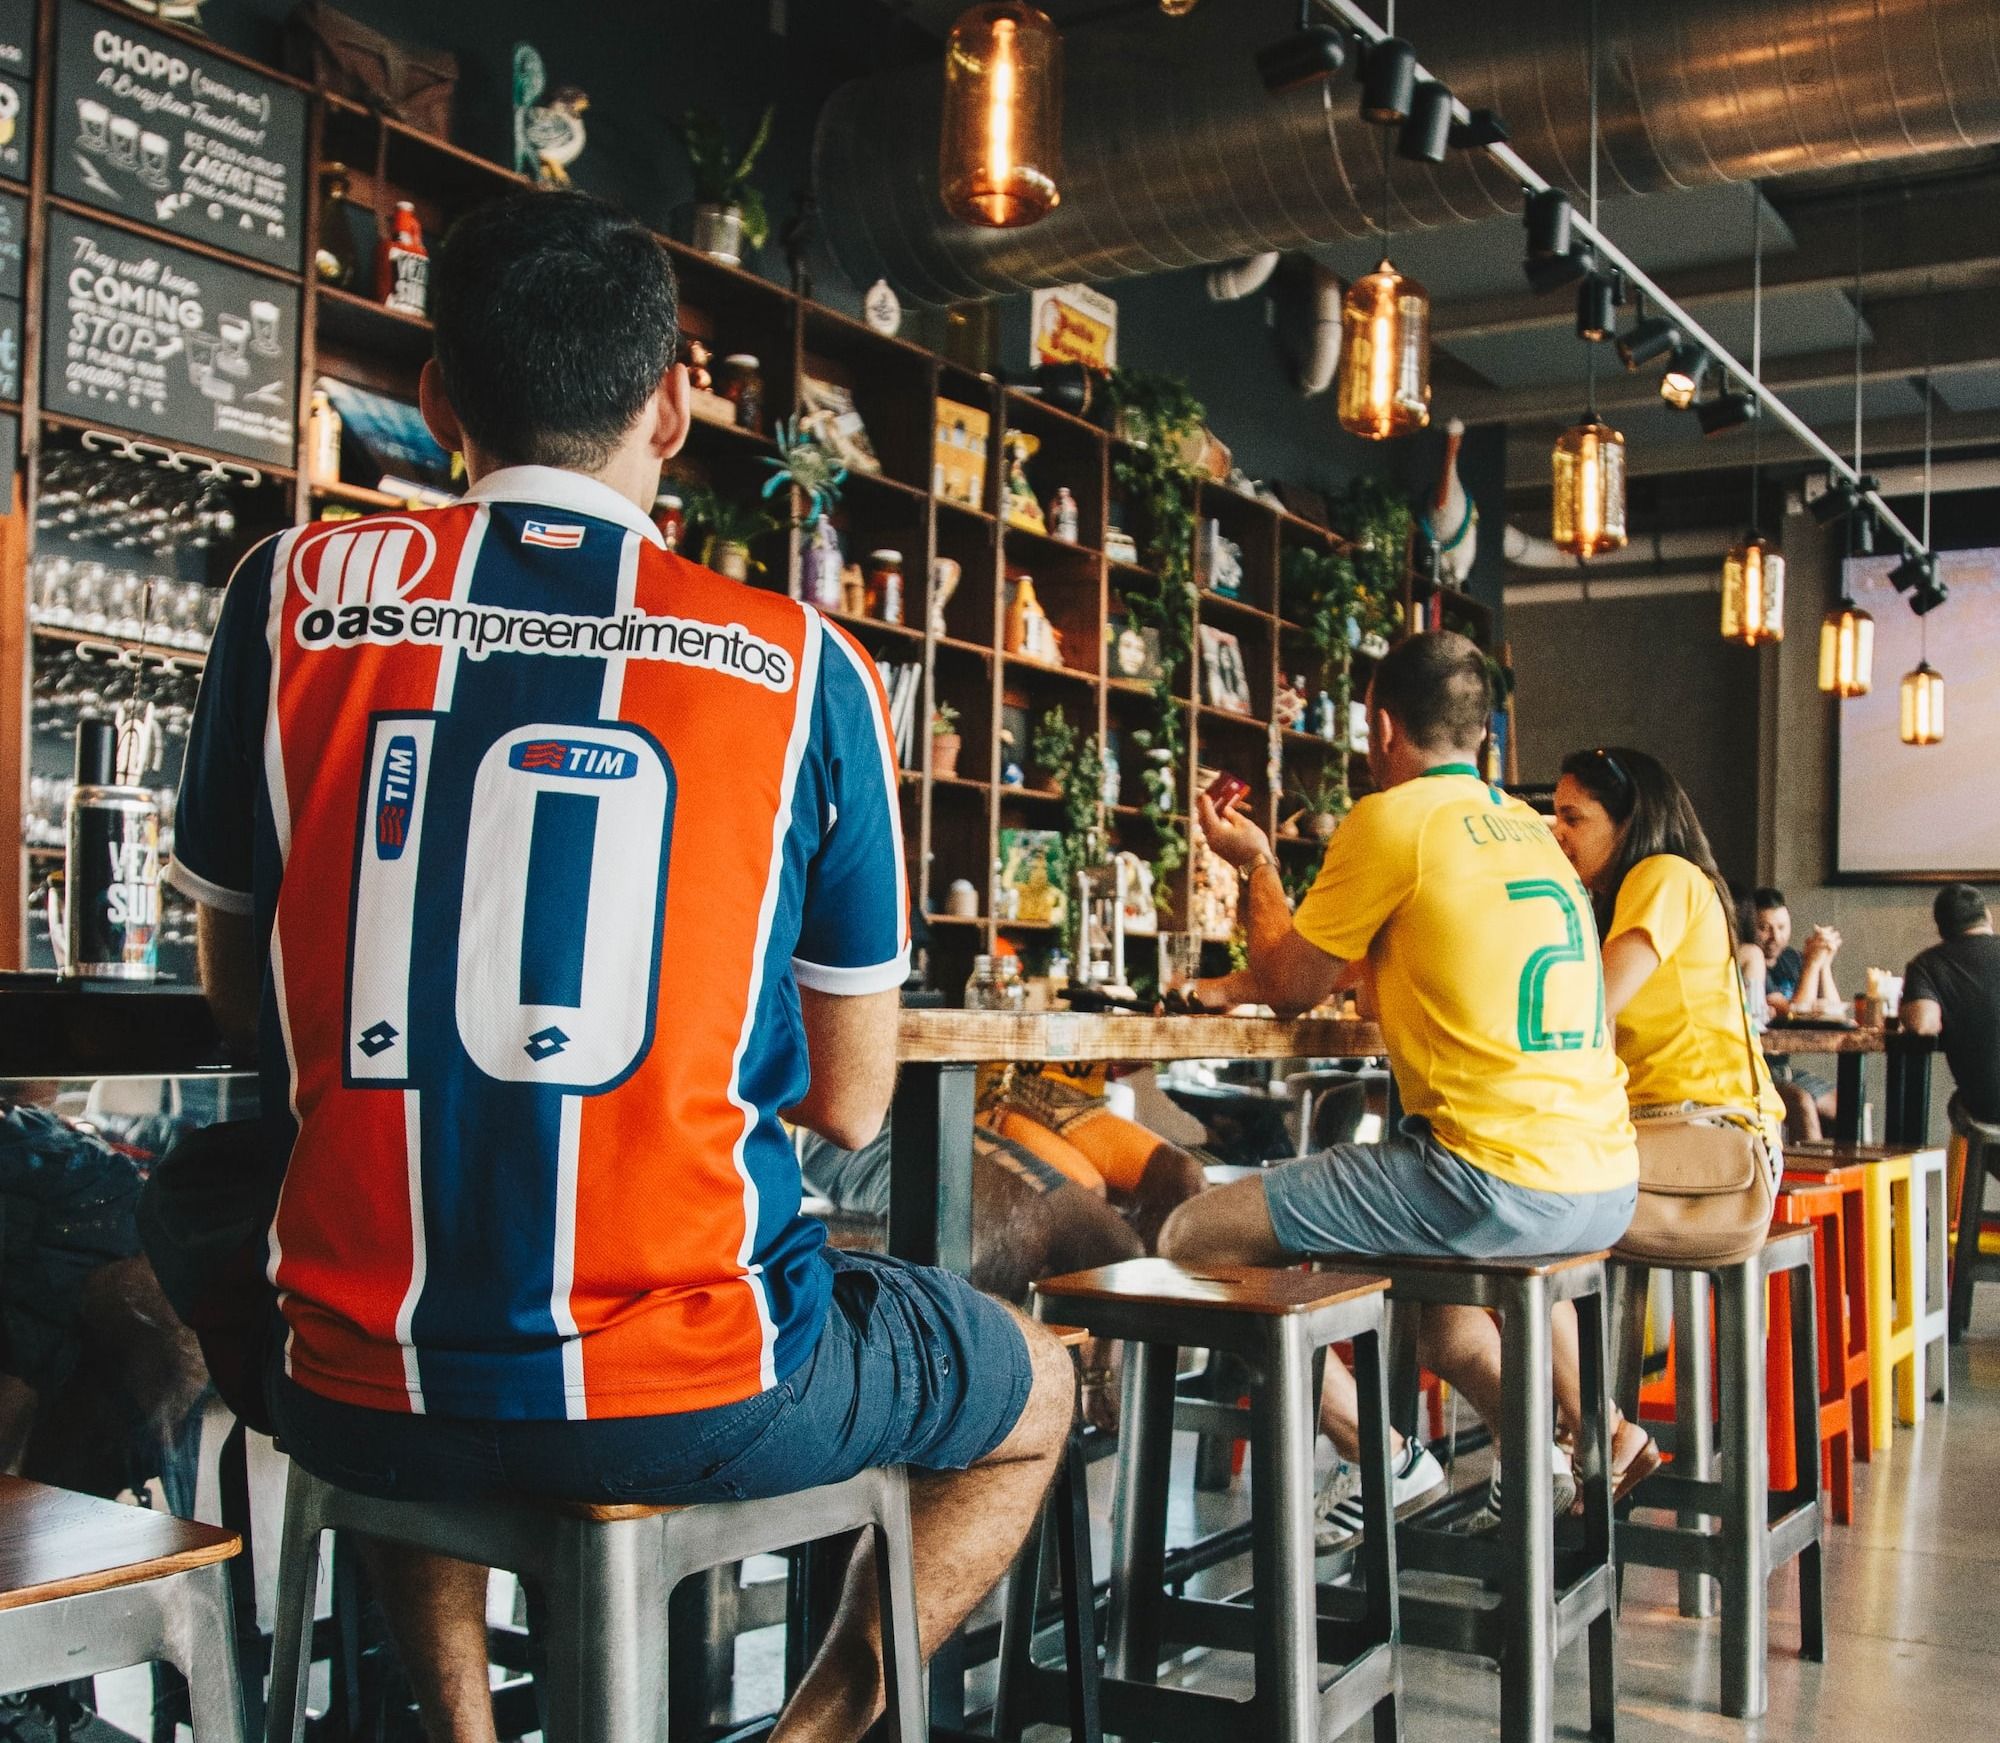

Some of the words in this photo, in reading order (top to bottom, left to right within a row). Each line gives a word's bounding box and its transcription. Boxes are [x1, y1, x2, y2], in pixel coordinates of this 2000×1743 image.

[93, 30, 190, 88] CHOPP
[71, 236, 120, 277] They
[68, 267, 205, 331] COMING
[68, 312, 158, 357] STOP
[301, 604, 405, 642] oas
[409, 605, 787, 686] empreendimentos
[383, 747, 414, 802] TIM
[568, 746, 627, 777] TIM
[350, 719, 669, 1088] 10
